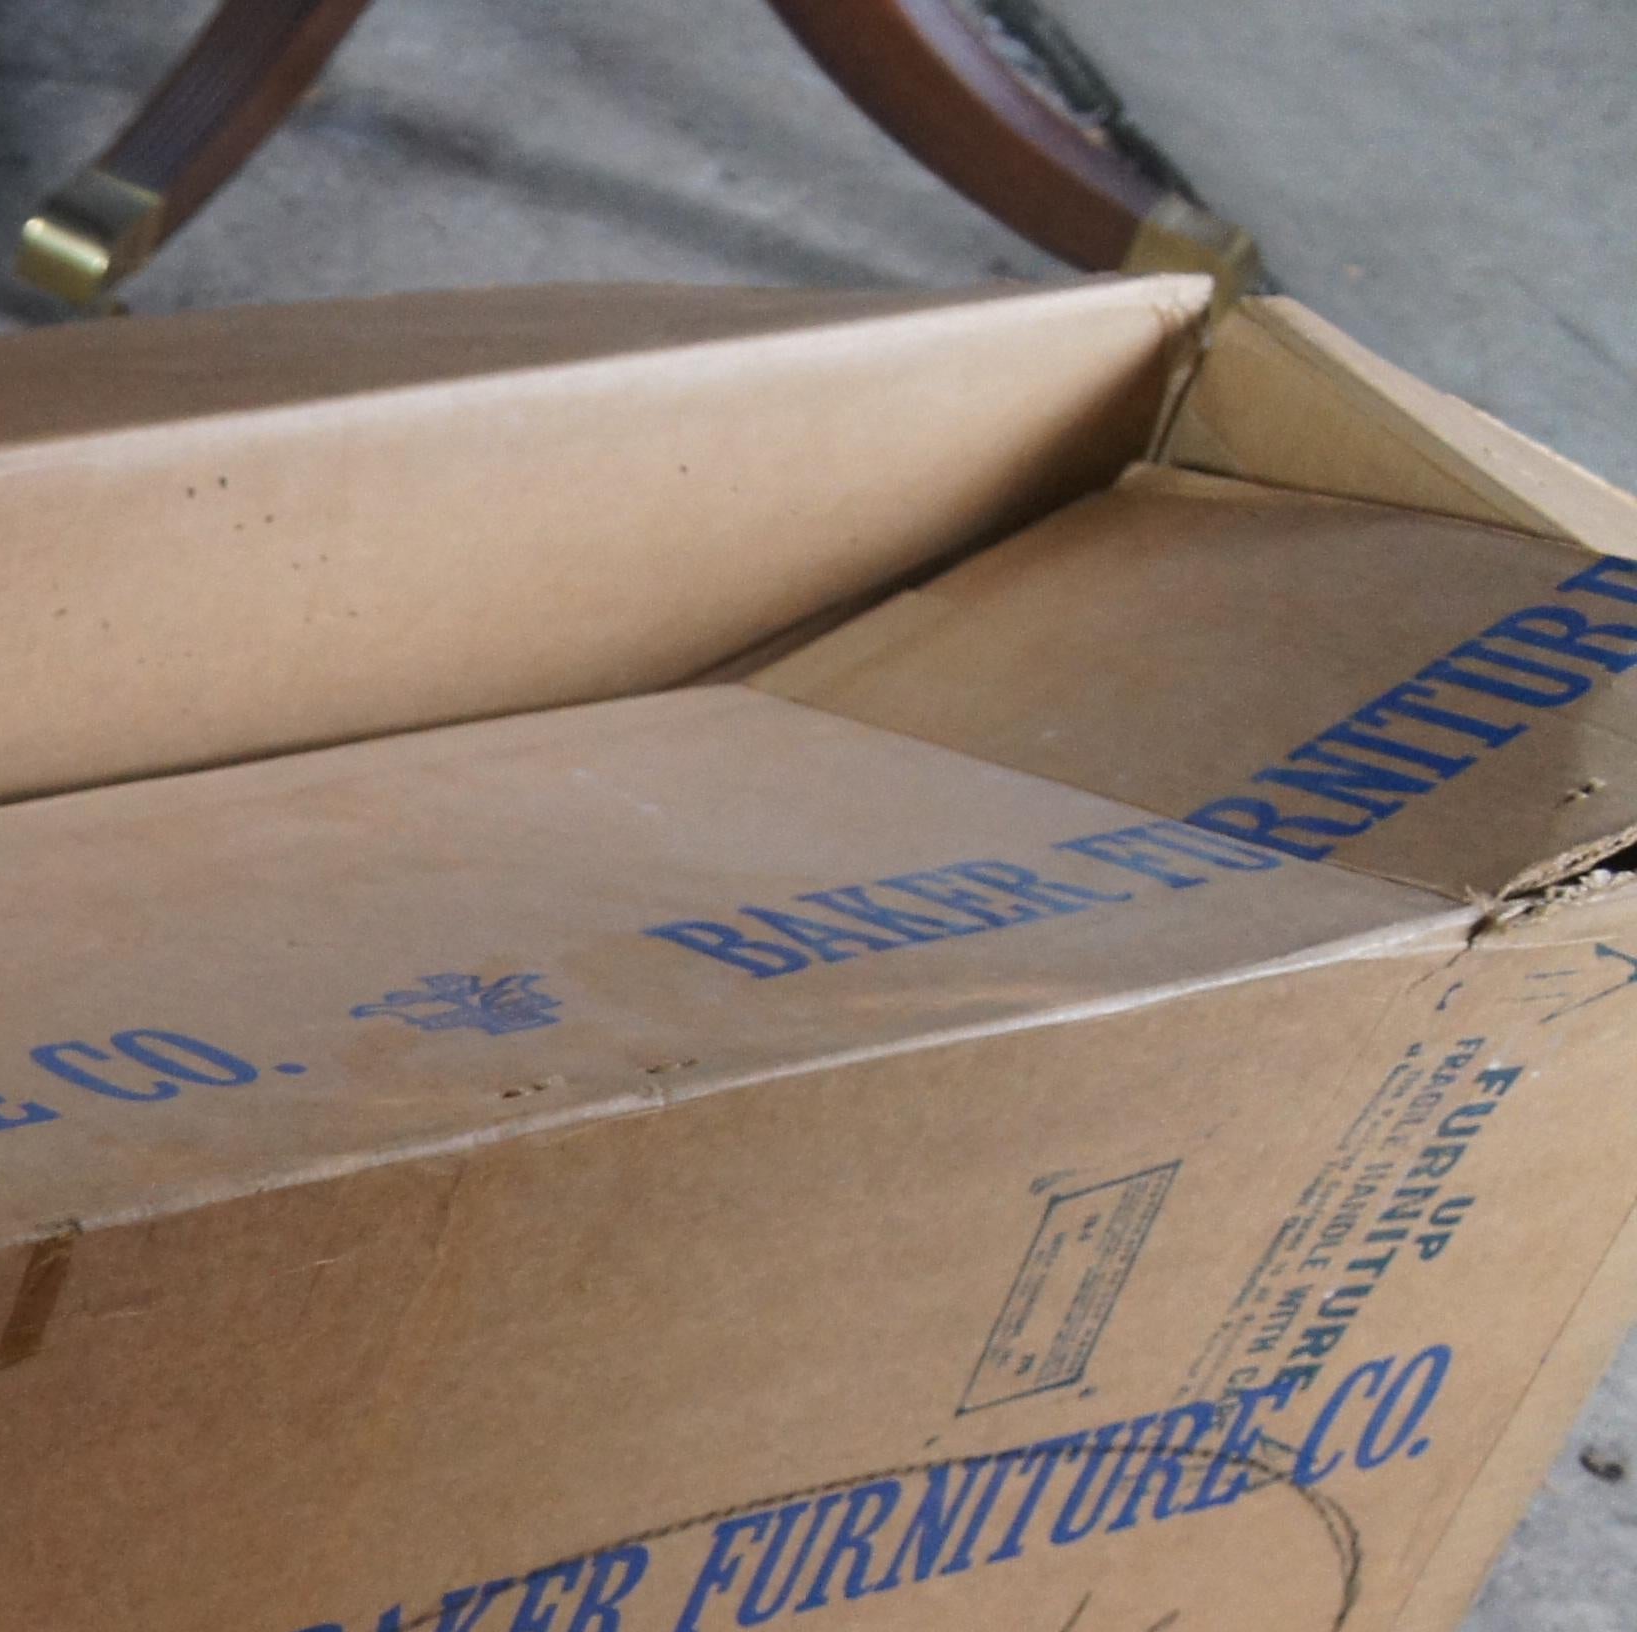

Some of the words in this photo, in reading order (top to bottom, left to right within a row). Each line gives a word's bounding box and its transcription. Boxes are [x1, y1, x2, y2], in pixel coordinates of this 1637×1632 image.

[641, 857, 1131, 980] BAKER
[29, 1027, 309, 1104] CO.
[1379, 1036, 1486, 1152] FRAGILE
[1272, 1065, 1524, 1391] FURNITURE
[1297, 1162, 1394, 1272] HANDLE
[1414, 1196, 1476, 1261] UP
[1245, 1284, 1315, 1355] WITH
[1290, 1343, 1453, 1489] CO.
